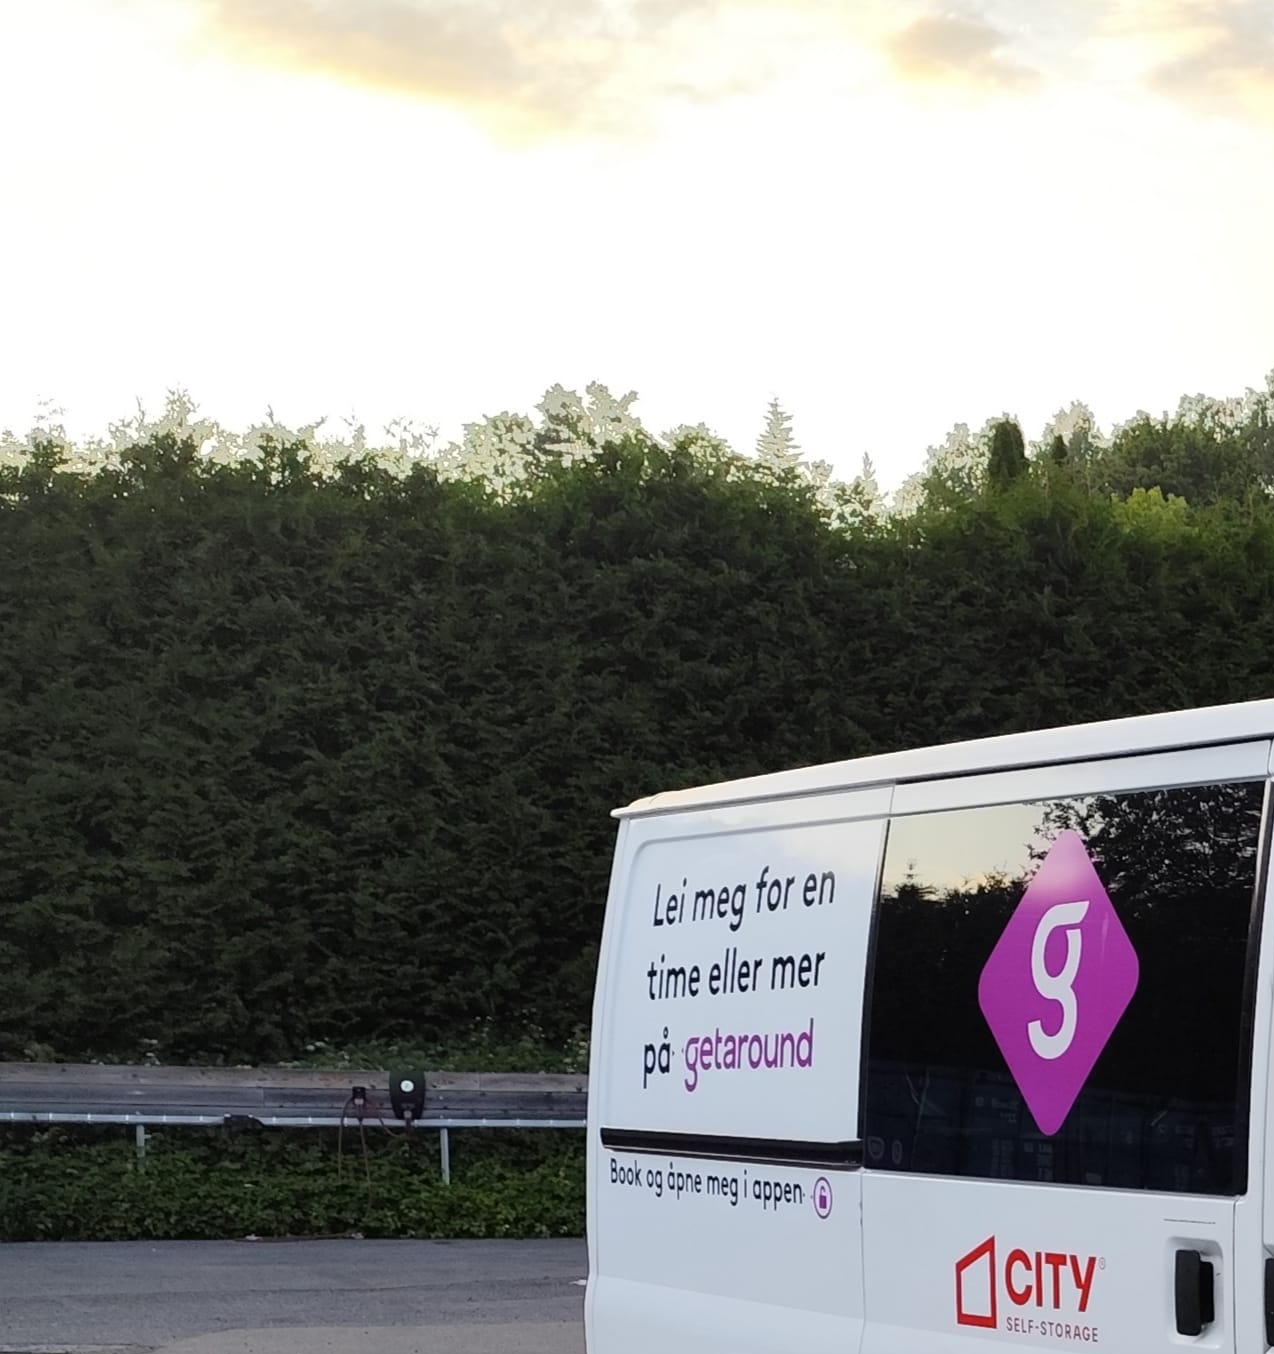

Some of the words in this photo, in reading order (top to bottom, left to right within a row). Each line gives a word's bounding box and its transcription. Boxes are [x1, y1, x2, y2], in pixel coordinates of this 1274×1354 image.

[652, 878, 688, 926] Lei
[692, 884, 746, 932] meg
[756, 866, 795, 913] for
[803, 869, 836, 907] en
[647, 954, 701, 1000] time
[708, 947, 763, 995] eller
[771, 951, 826, 990] mer
[1027, 900, 1091, 1060] g
[643, 1026, 671, 1089] på
[684, 1018, 814, 1092] getaround
[610, 1158, 643, 1186] Book
[646, 1169, 664, 1198] og
[667, 1162, 702, 1200] åpne
[706, 1176, 739, 1206] meg
[743, 1169, 748, 1198] i
[752, 1178, 803, 1211] appen
[1004, 1248, 1097, 1313] CITY
[1006, 1316, 1100, 1343] SELF-STORAGE
